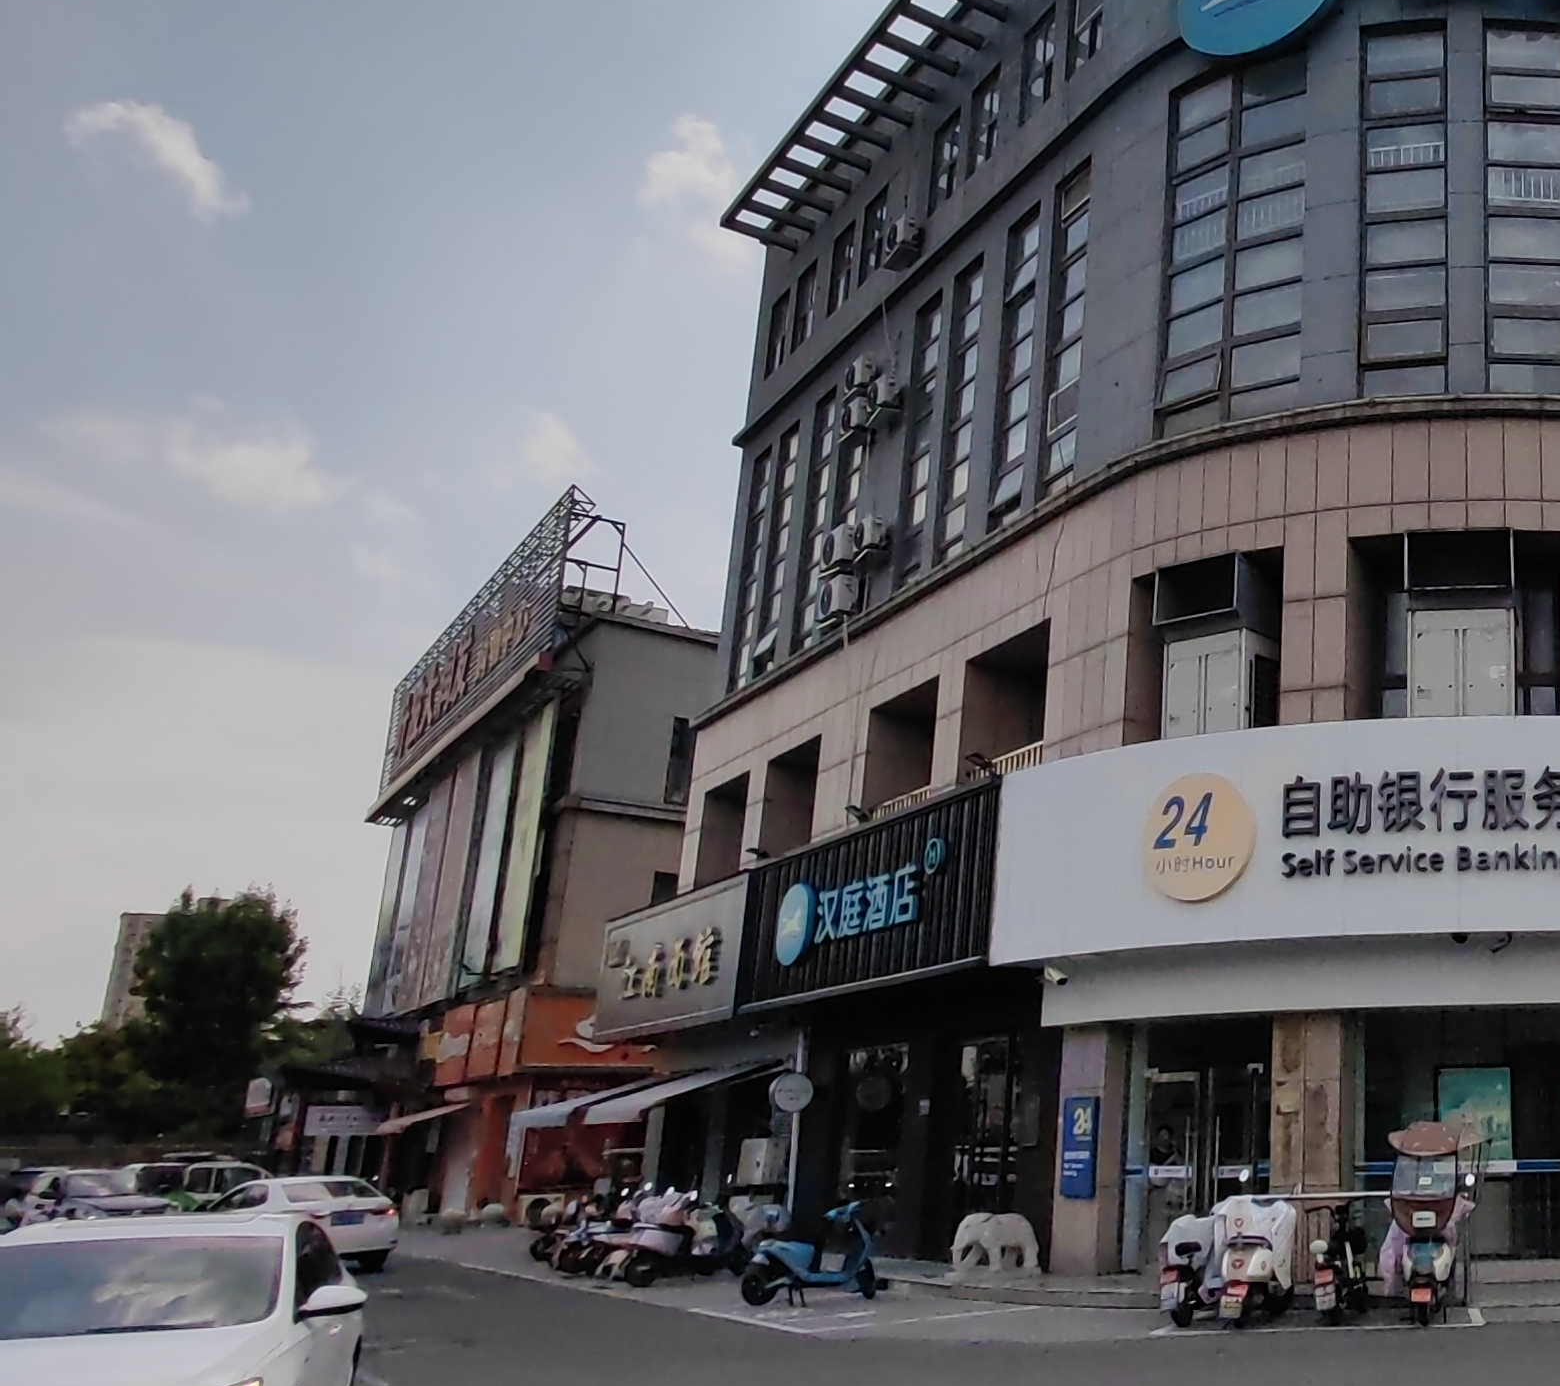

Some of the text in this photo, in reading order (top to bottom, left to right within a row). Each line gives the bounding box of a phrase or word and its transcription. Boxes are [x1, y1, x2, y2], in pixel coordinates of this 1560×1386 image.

[1153, 792, 1213, 850] 24
[1281, 848, 1335, 878] Self
[1343, 846, 1444, 875] Service
[814, 863, 918, 944] 汉庭酒店
[1073, 1107, 1093, 1135] 24
